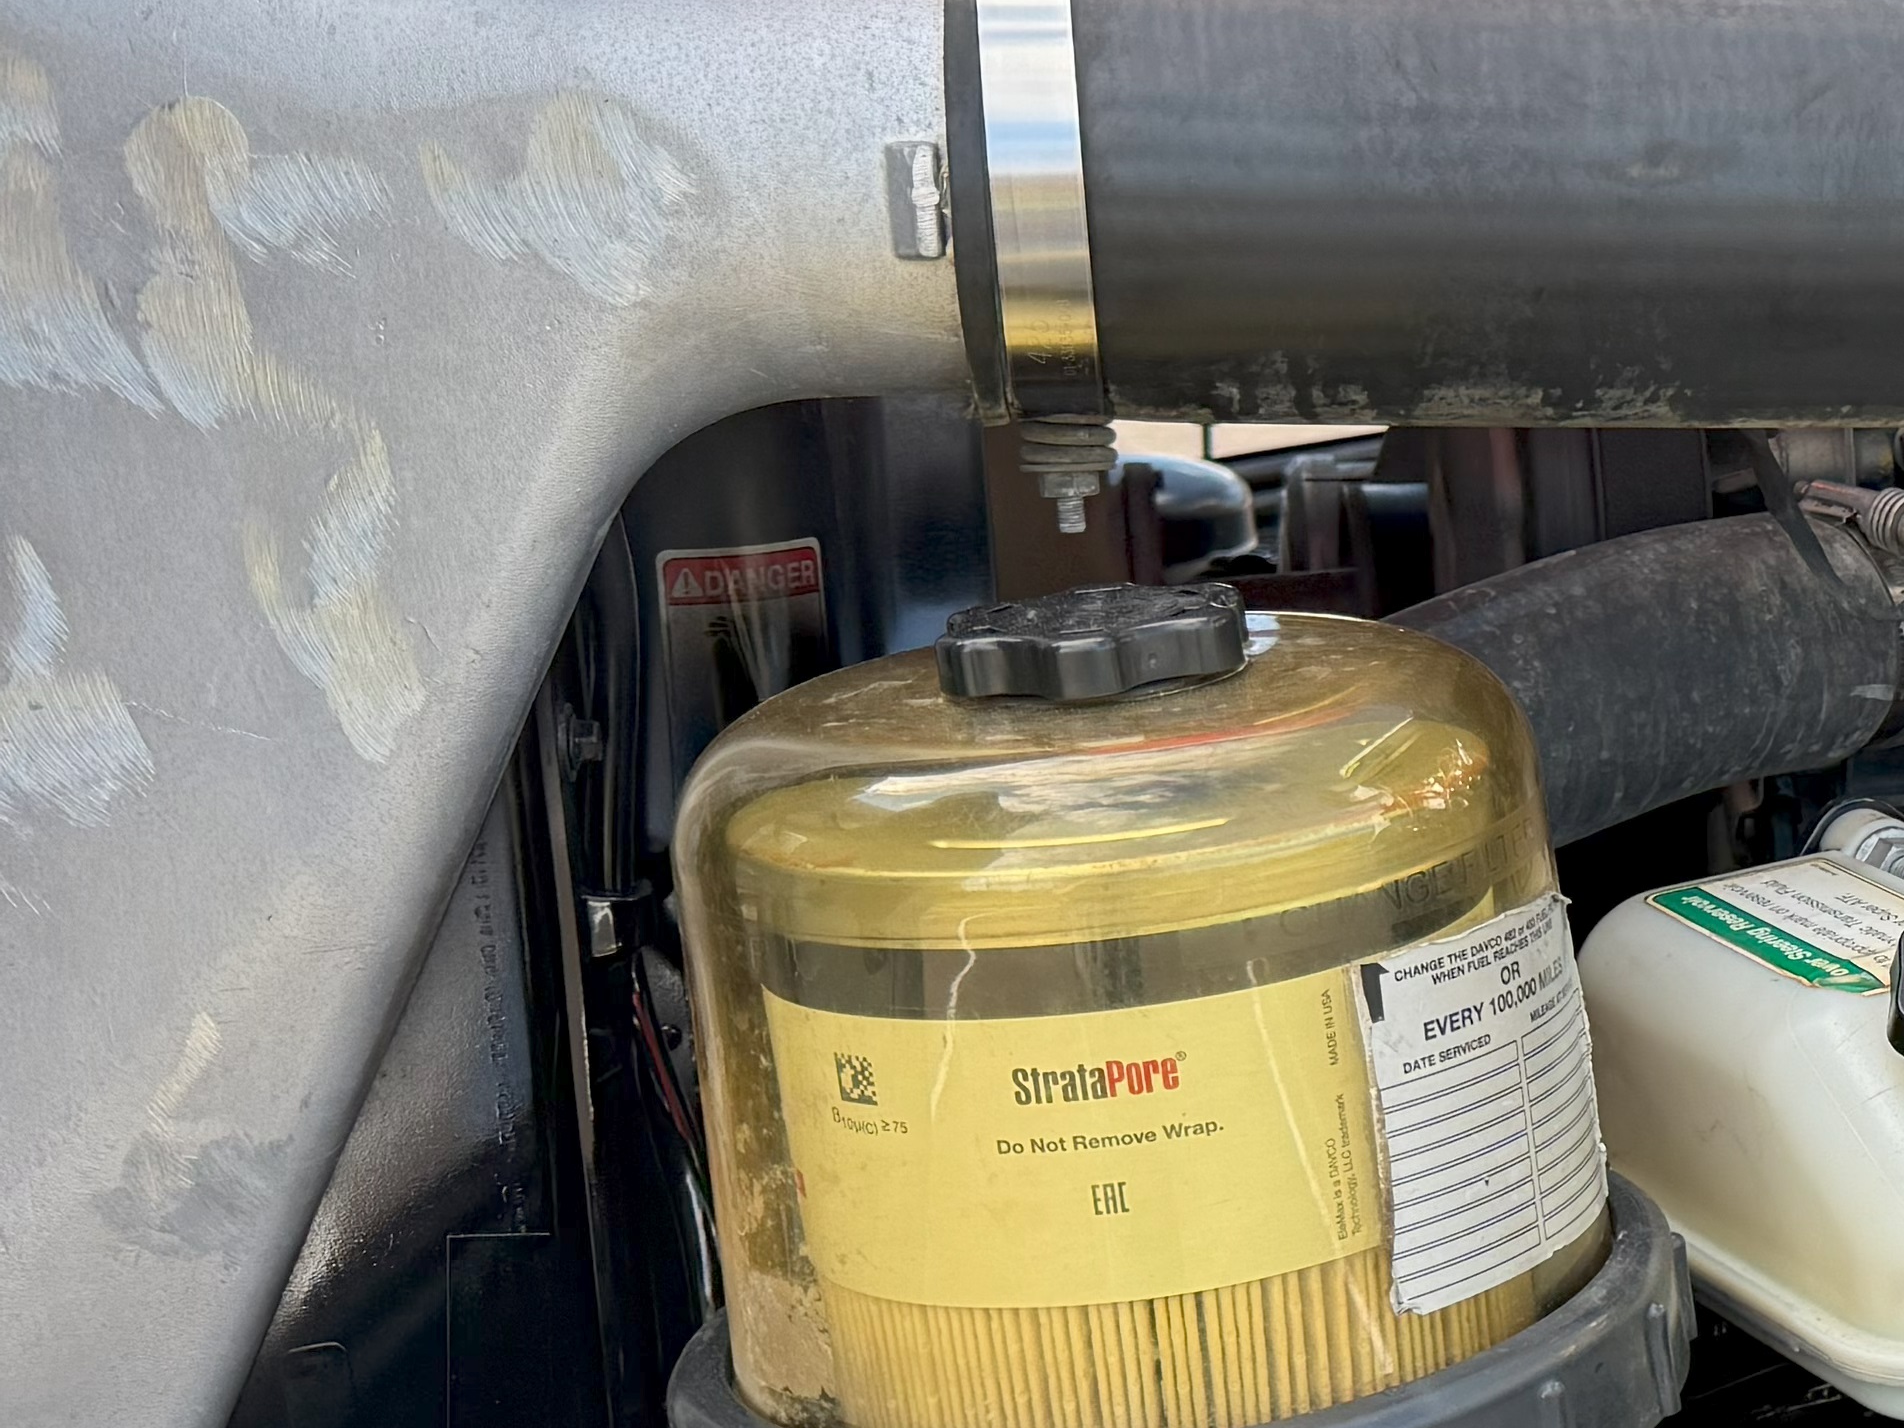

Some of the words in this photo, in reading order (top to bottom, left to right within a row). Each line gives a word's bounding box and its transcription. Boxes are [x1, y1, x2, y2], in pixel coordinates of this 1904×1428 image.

[703, 559, 816, 598] DANGER
[1680, 893, 1751, 932] Reservoir
[1394, 956, 1445, 983] CHANGE
[1447, 949, 1468, 966] THE
[1470, 935, 1503, 959] DAVCO
[1431, 965, 1466, 986] WHEN
[1467, 955, 1492, 977] FUEL
[1493, 935, 1530, 964] REACHES
[1749, 923, 1807, 961] Steering
[1499, 960, 1522, 986] OR
[1320, 987, 1332, 1015] USA
[1423, 1002, 1484, 1042] EVERY
[1489, 978, 1538, 1016] 100,000
[1324, 1015, 1333, 1028] IN
[1326, 1029, 1339, 1067] MADE
[1402, 1055, 1437, 1075] DATE
[1438, 1033, 1492, 1063] SERVICED
[996, 1138, 1024, 1155] Do
[1030, 1136, 1067, 1154] Not
[1072, 1128, 1158, 1151] Remove
[1162, 1119, 1225, 1140] Wrap.
